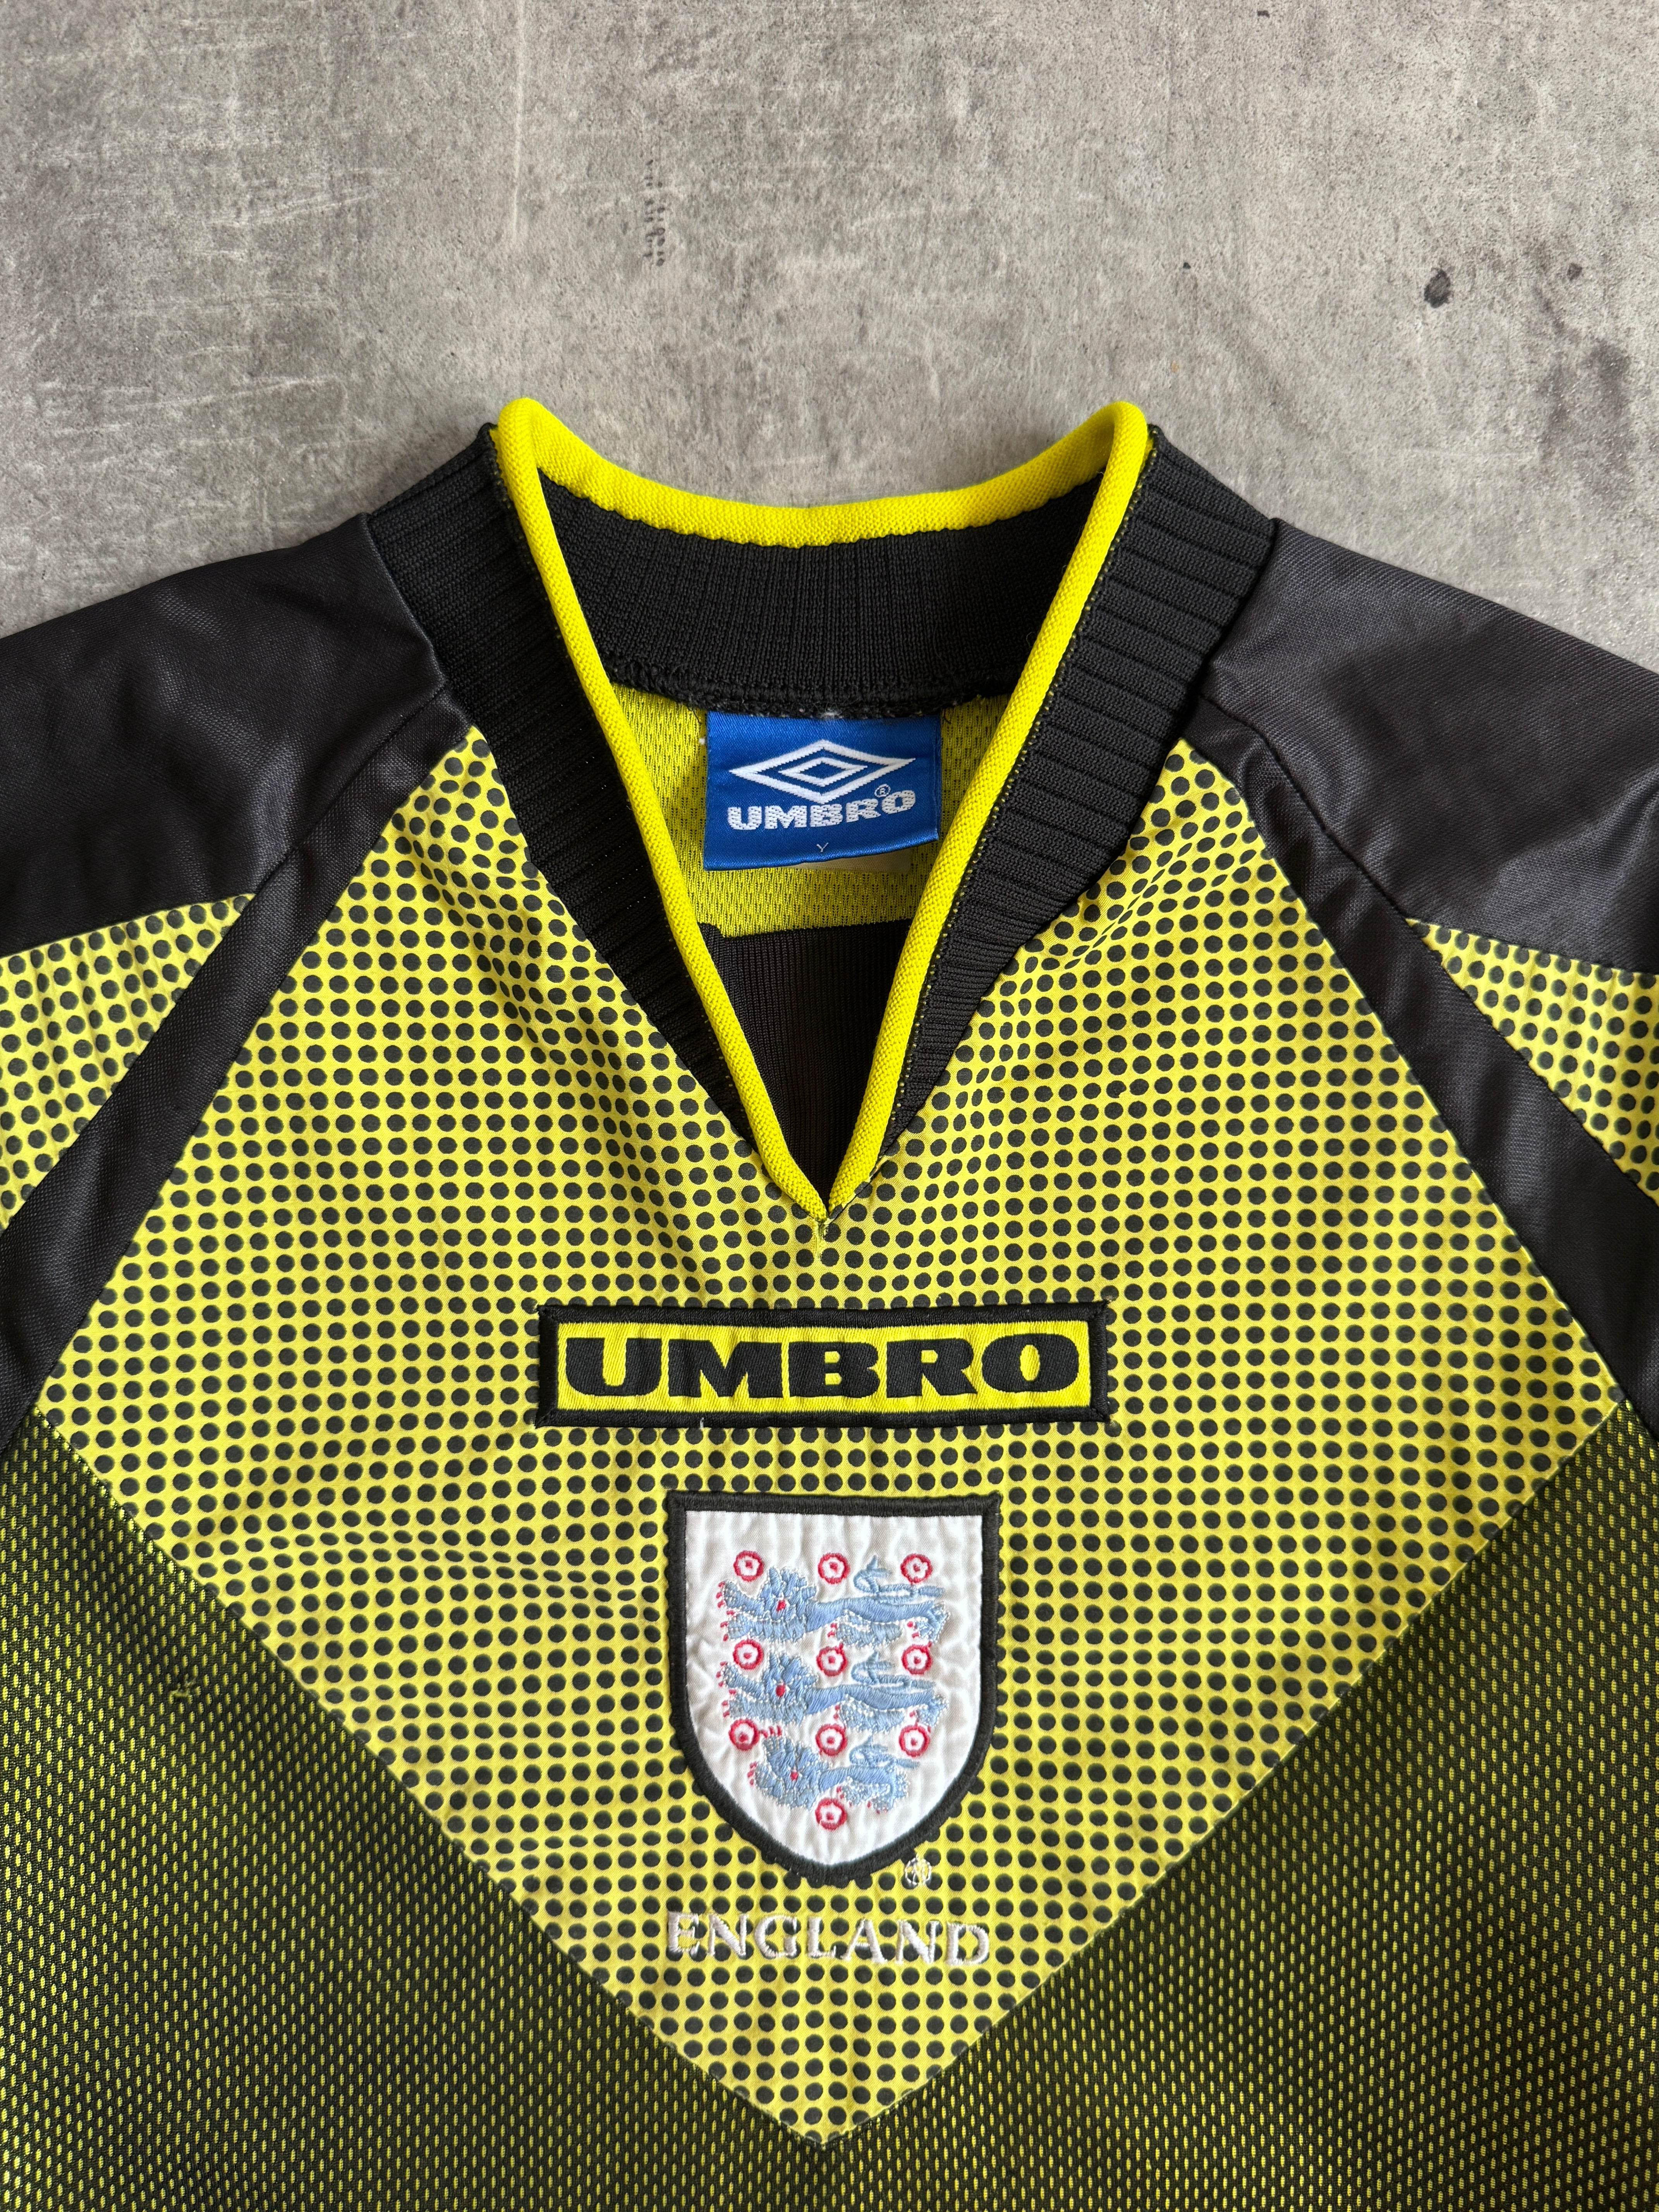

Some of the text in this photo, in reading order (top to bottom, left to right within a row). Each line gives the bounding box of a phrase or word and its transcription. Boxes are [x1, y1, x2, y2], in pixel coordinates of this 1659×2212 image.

[727, 790, 916, 830] UMBRO
[565, 1332, 1080, 1399] UMBRO
[668, 1910, 990, 1966] ENGLAND
